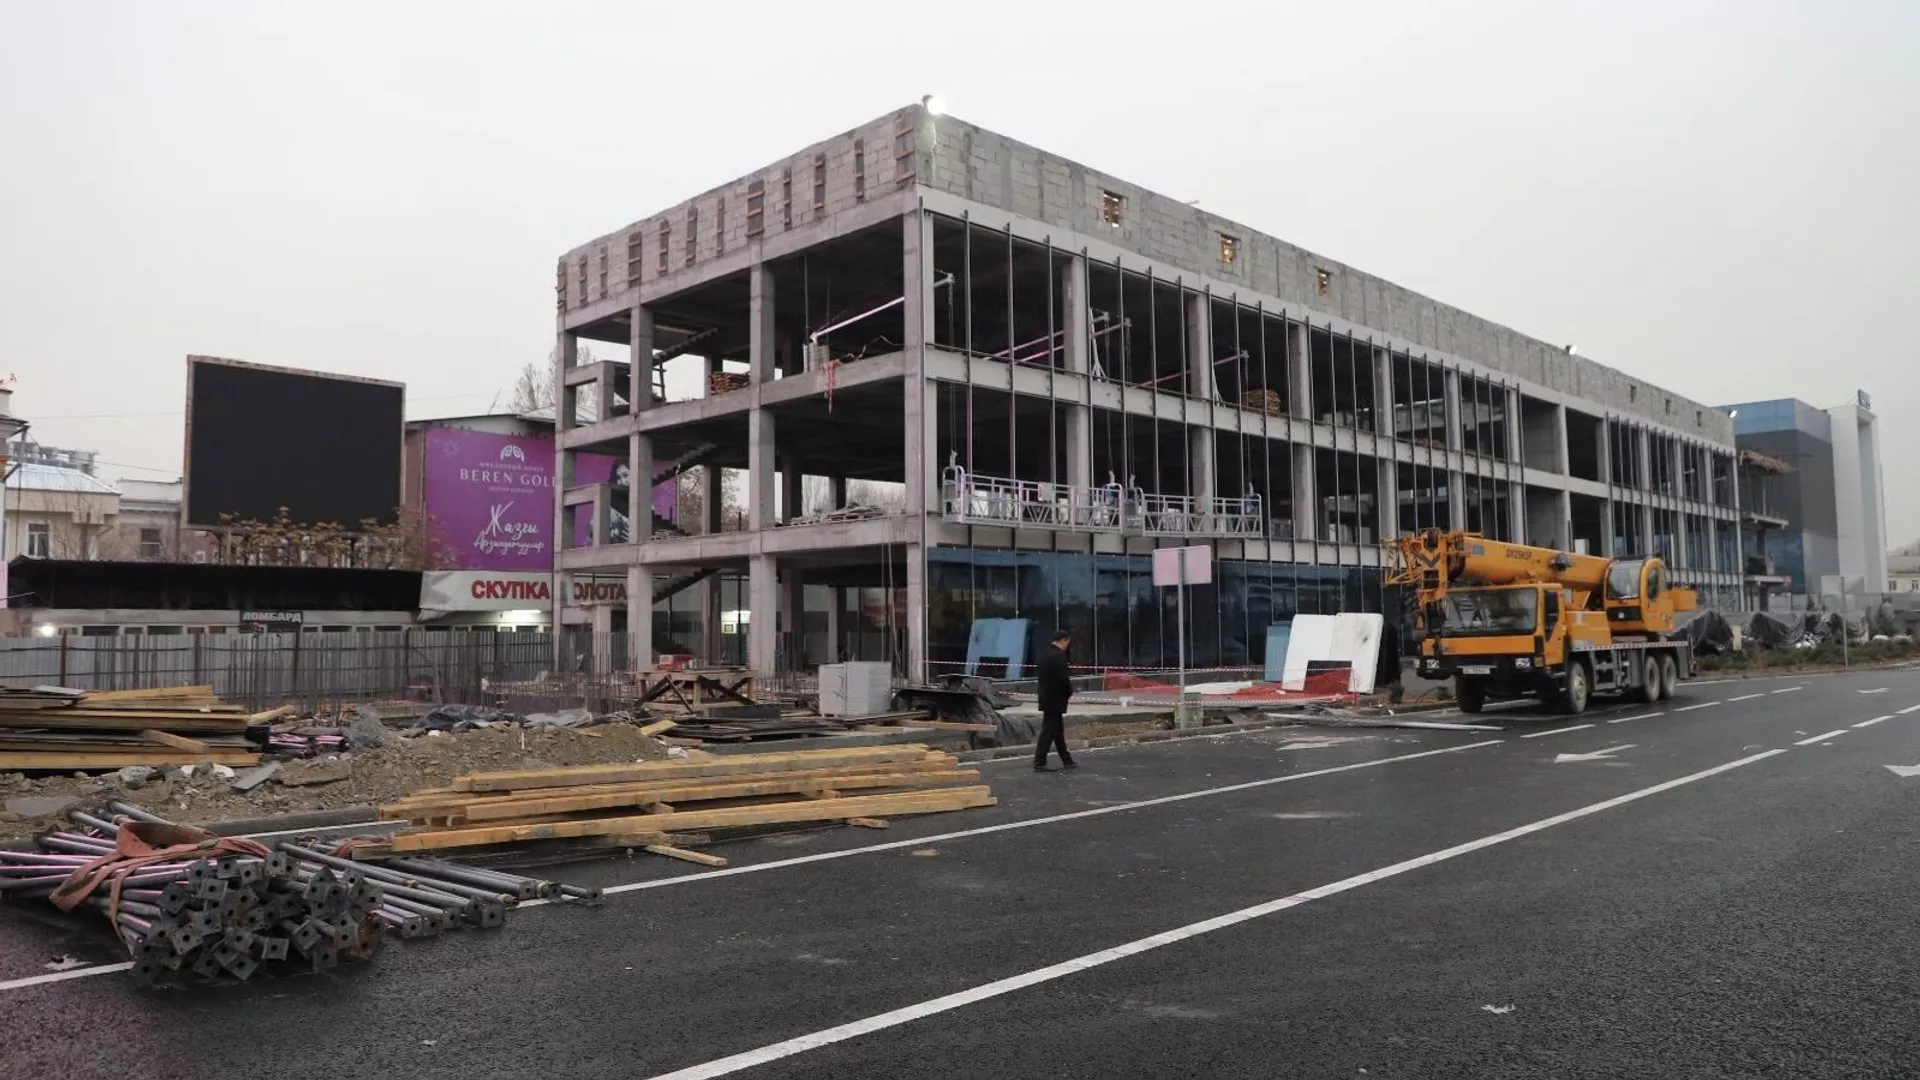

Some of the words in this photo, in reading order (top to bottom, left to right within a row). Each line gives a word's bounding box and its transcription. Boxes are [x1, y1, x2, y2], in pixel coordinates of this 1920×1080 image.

[460, 468, 513, 484] BEREN
[485, 501, 539, 540] Жазгы
[471, 580, 550, 600] СКУПКА
[573, 582, 628, 600] ОЛОТА
[243, 612, 302, 623] ЛОМБАРД
